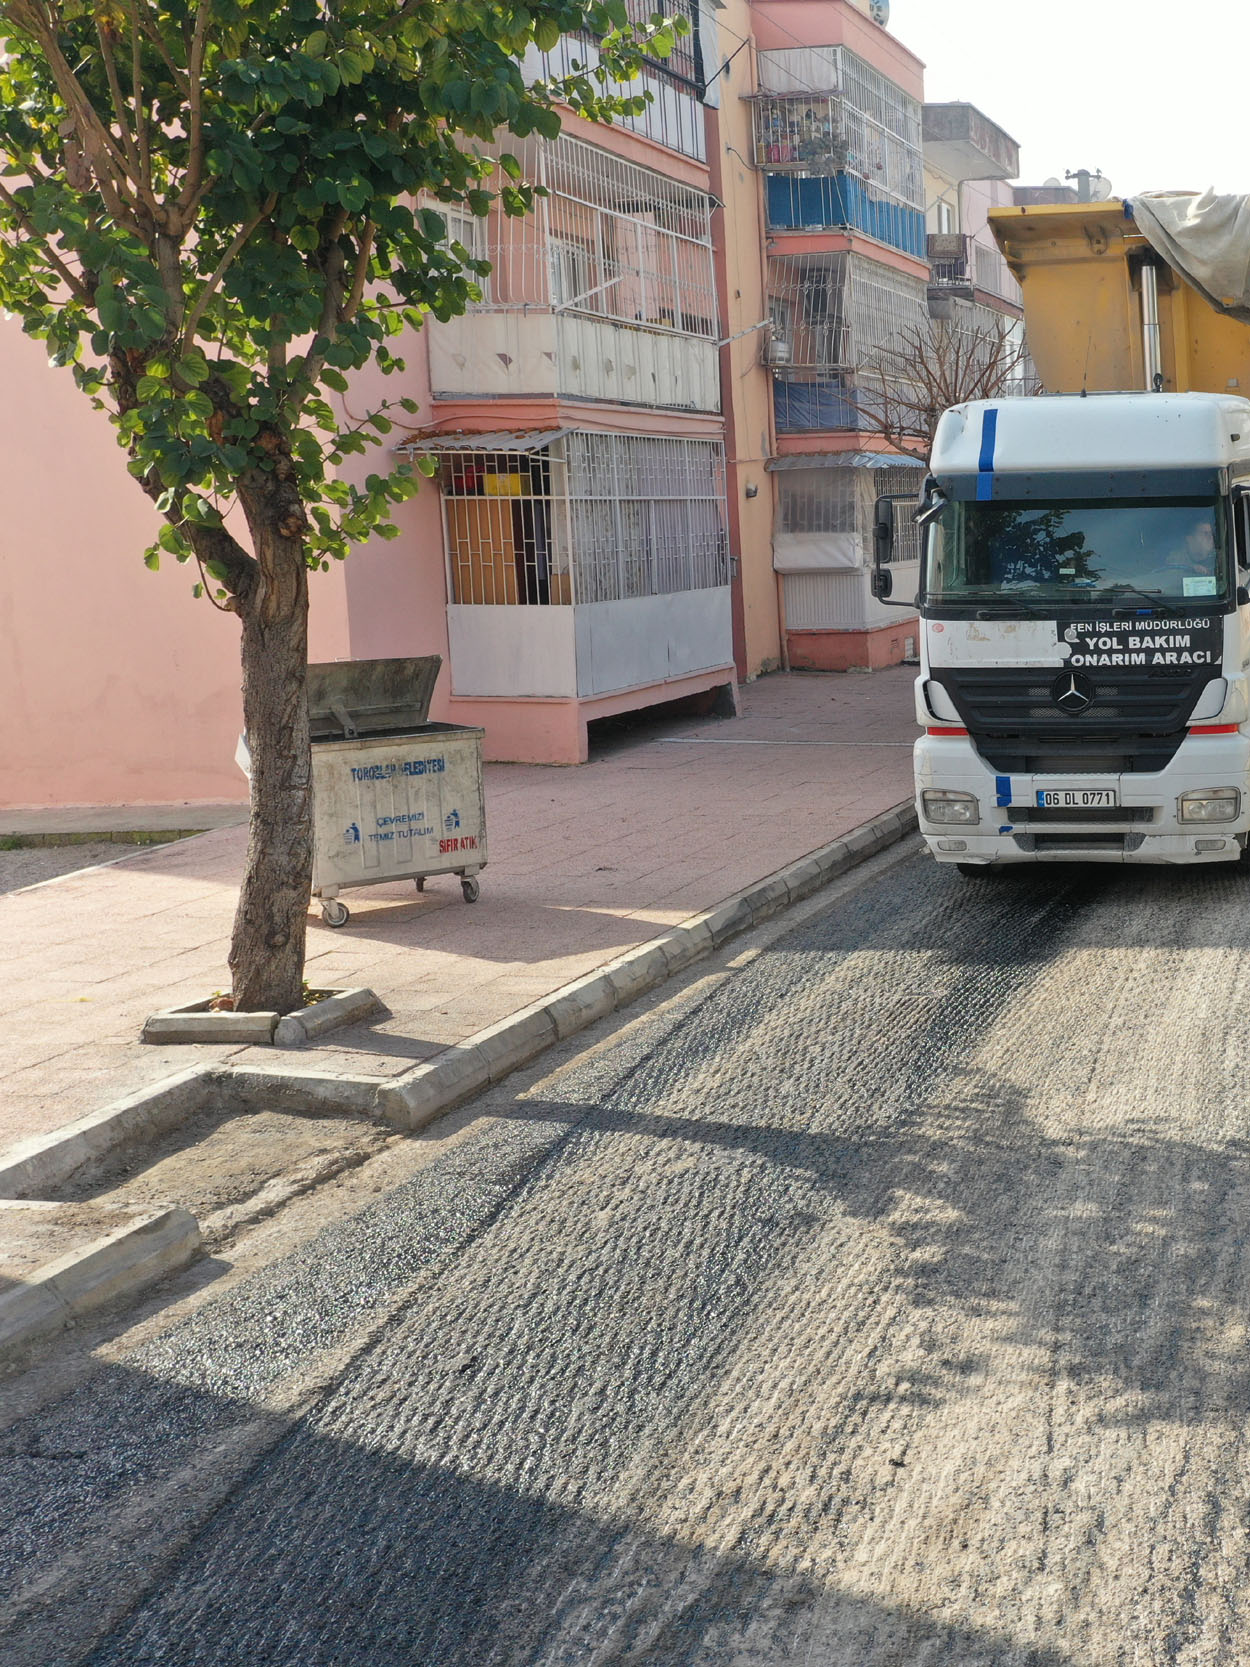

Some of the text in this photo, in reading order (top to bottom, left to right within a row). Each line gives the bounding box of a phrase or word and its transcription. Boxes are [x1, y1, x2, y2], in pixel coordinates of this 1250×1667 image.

[1096, 620, 1132, 634] İŞLERİ
[1135, 618, 1210, 631] MÜDÜRLÜĞÜ
[1085, 635, 1191, 650] YOL BAKIM
[1071, 651, 1211, 666] ONARIM ARACI
[1045, 792, 1110, 806] 06 DL 0771
